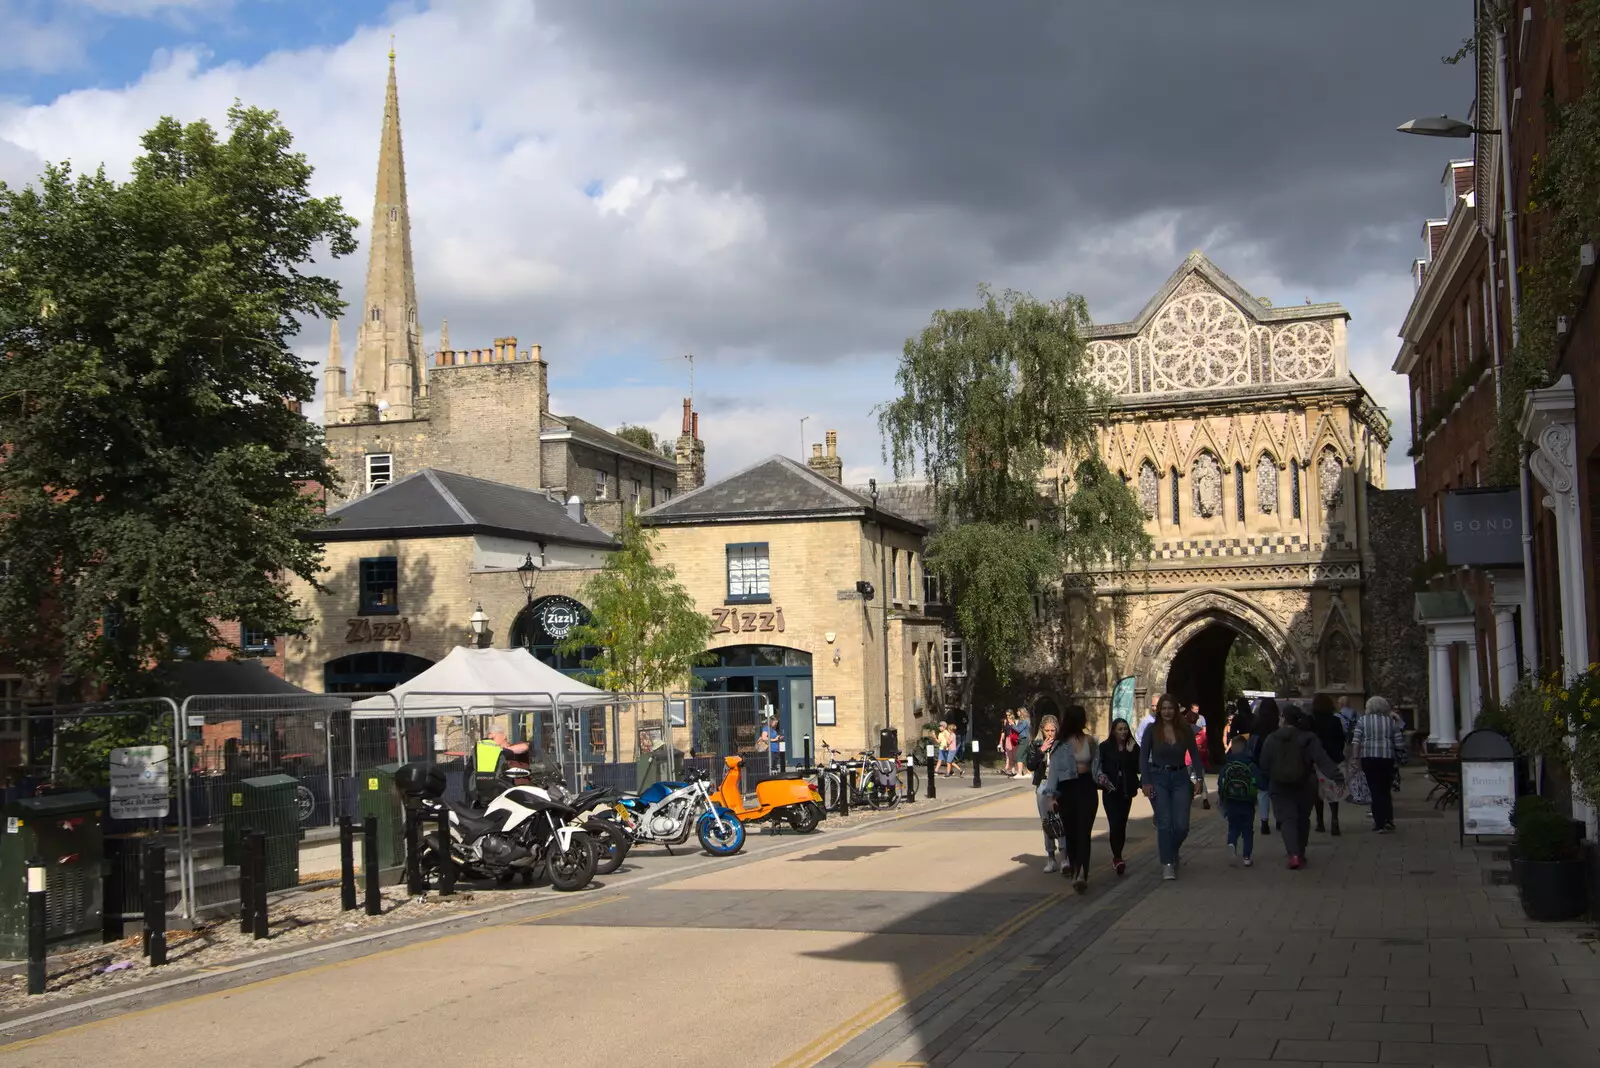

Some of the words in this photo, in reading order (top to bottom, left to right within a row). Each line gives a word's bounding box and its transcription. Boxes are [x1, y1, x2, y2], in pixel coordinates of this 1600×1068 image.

[1453, 518, 1513, 532] BOND
[548, 614, 573, 624] Zizzi
[711, 606, 786, 634] Zizzi
[346, 617, 411, 641] Zizzi
